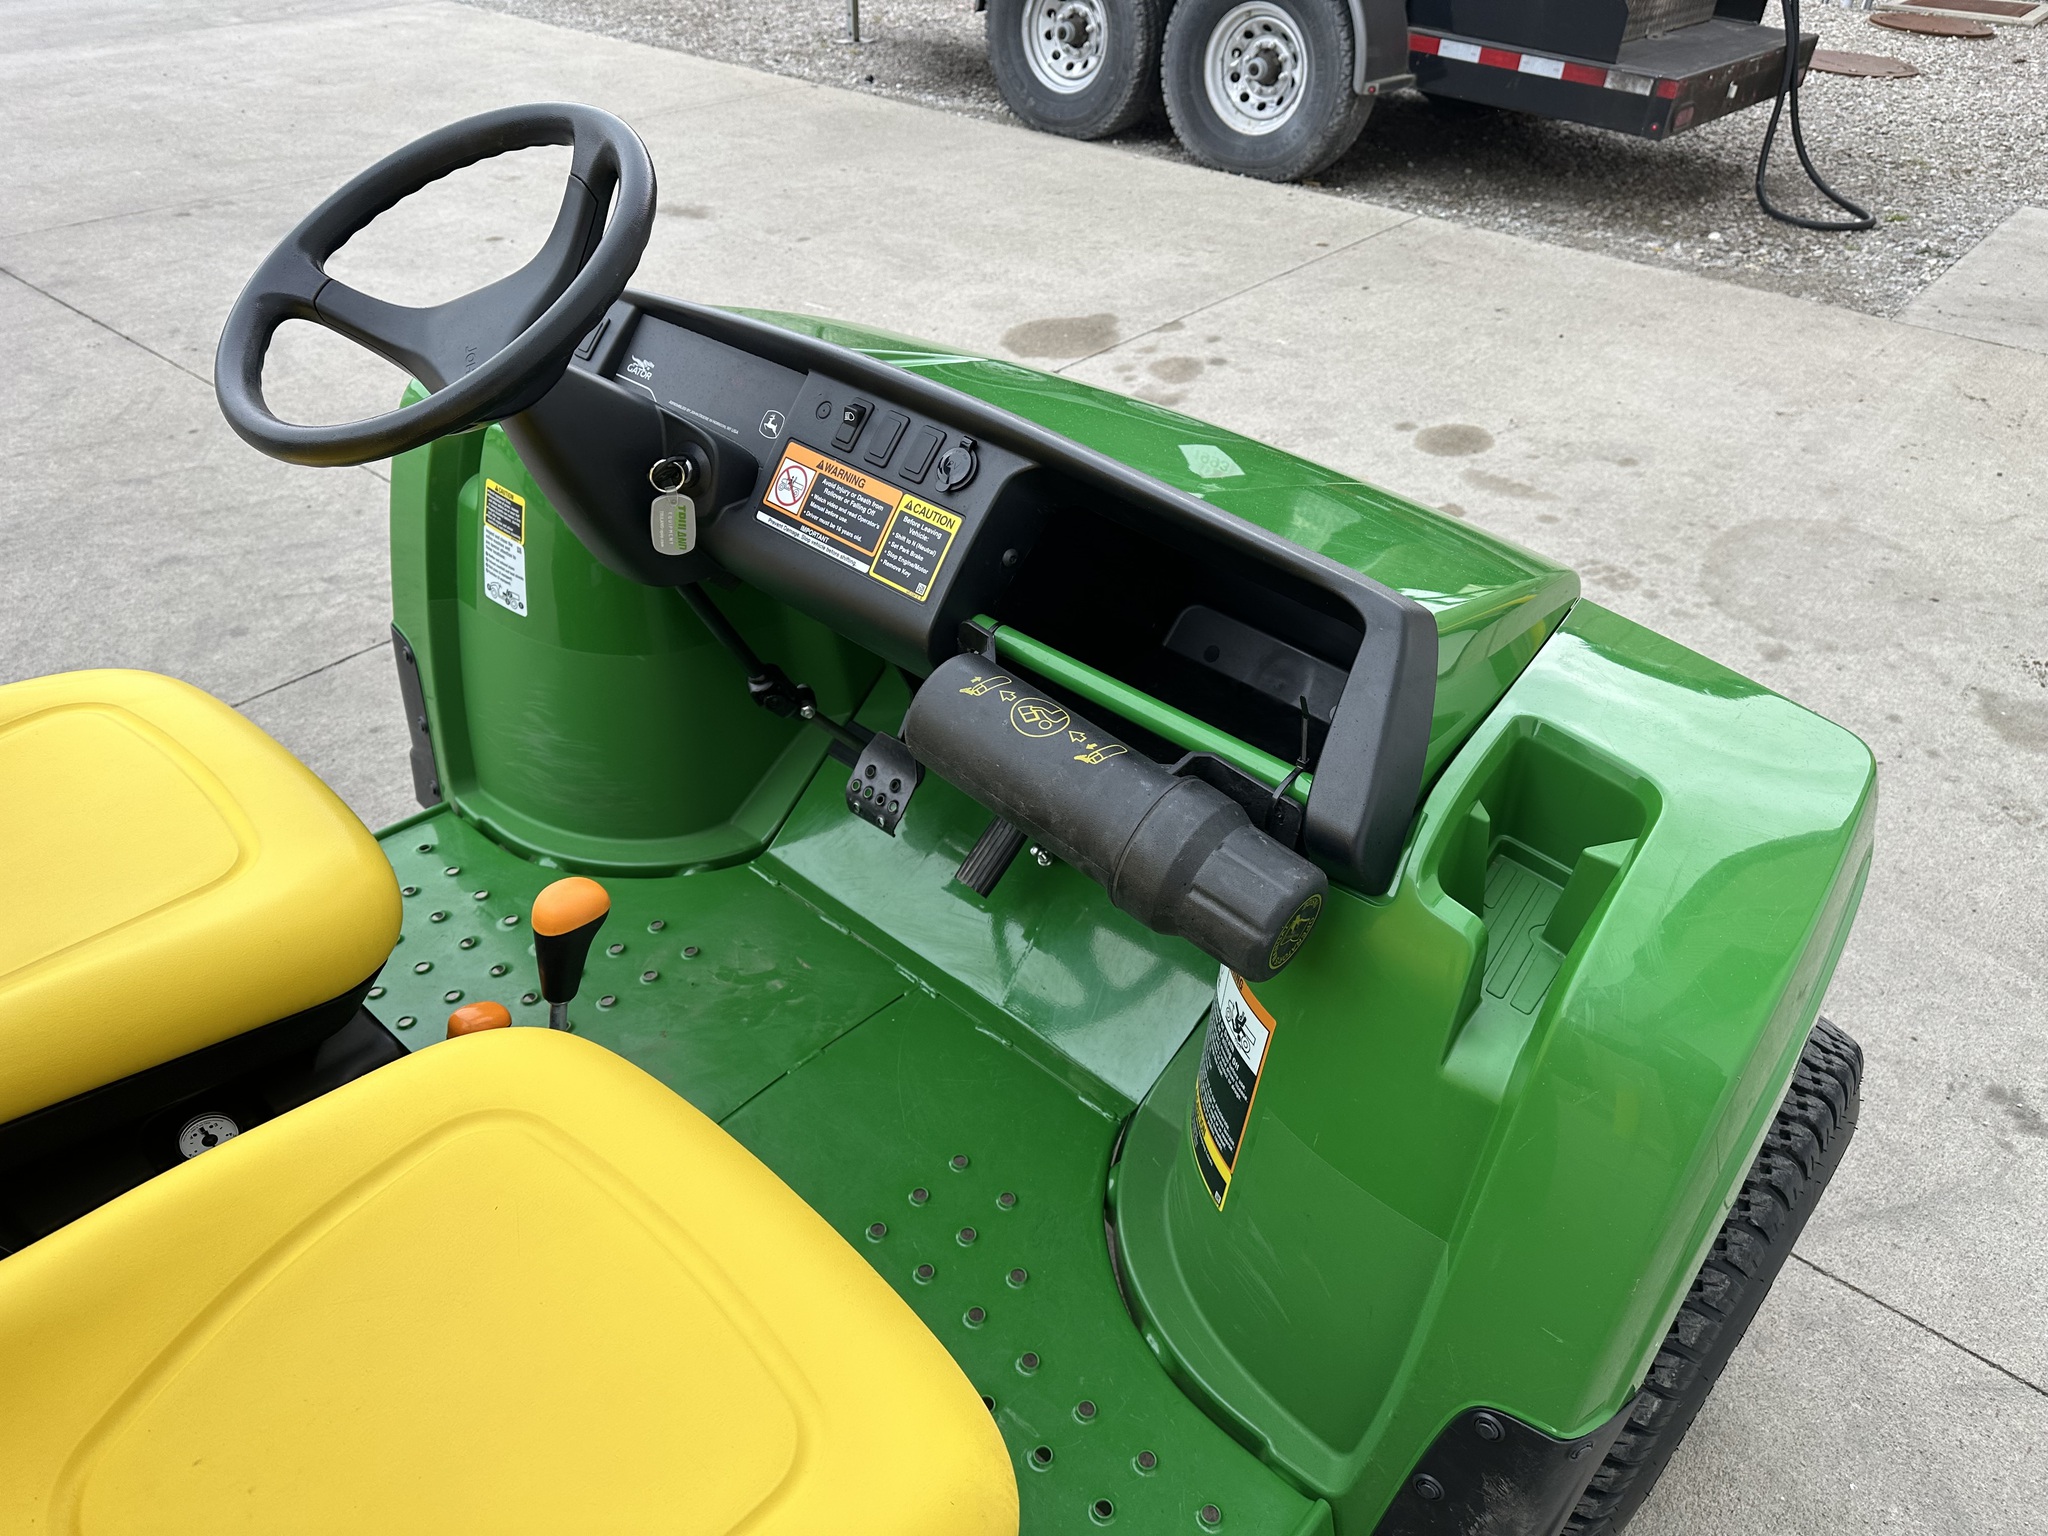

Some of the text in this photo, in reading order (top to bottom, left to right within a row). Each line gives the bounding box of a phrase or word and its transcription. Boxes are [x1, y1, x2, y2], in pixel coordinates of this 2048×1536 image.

[627, 363, 653, 380] GATOR
[825, 460, 866, 489] WARNING
[822, 479, 835, 490] Avoid
[836, 485, 850, 497] Injury
[856, 494, 872, 506] Death
[871, 501, 884, 512] from
[823, 488, 844, 501] Rollover
[850, 500, 866, 514] Falling
[866, 508, 876, 516] Off
[809, 501, 824, 514] Manual
[825, 508, 838, 520] before
[813, 494, 880, 530] Watch video and read Operator's
[913, 503, 955, 530] CAUTION
[767, 517, 783, 529] Prevent
[800, 531, 811, 544] Stop
[811, 538, 825, 551] vehicle
[825, 544, 839, 557] before
[800, 525, 829, 543] IMPORTANT
[805, 510, 819, 521] Driver
[819, 517, 830, 527] must
[841, 528, 853, 539] years
[902, 515, 942, 540] Before Leaving
[908, 527, 929, 542] Vehicle:
[891, 541, 924, 561] Set Park Brake
[894, 532, 906, 542] Shift
[916, 542, 937, 557] (Neutral)
[883, 559, 911, 578] Remove Key
[886, 550, 929, 575] Stop Engine/Motor
